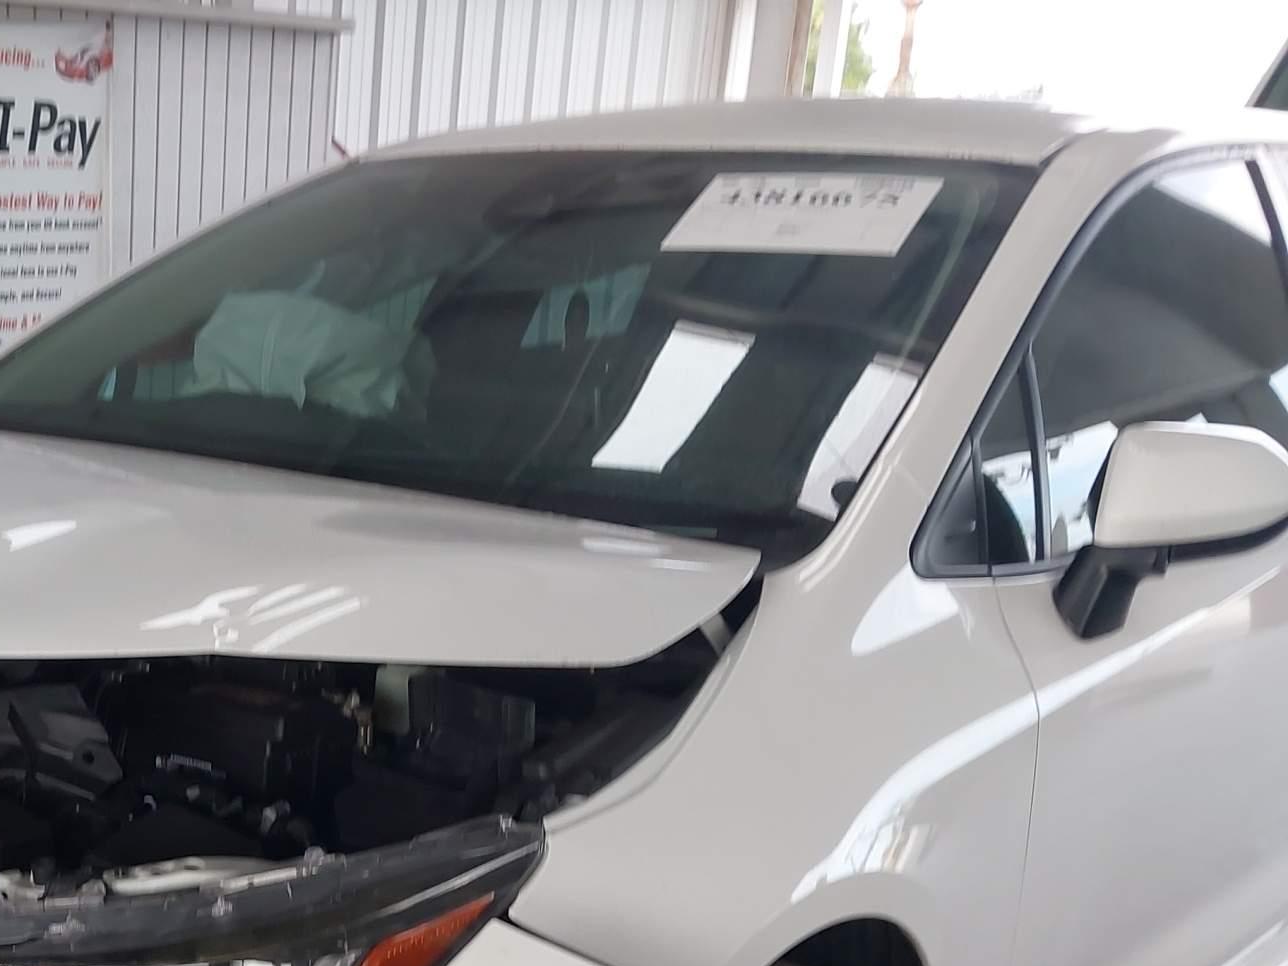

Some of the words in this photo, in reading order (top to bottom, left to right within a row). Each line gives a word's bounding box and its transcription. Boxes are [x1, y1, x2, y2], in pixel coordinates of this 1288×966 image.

[35, 190, 59, 214] Way
[63, 190, 74, 210] to
[78, 189, 103, 214] Pay!
